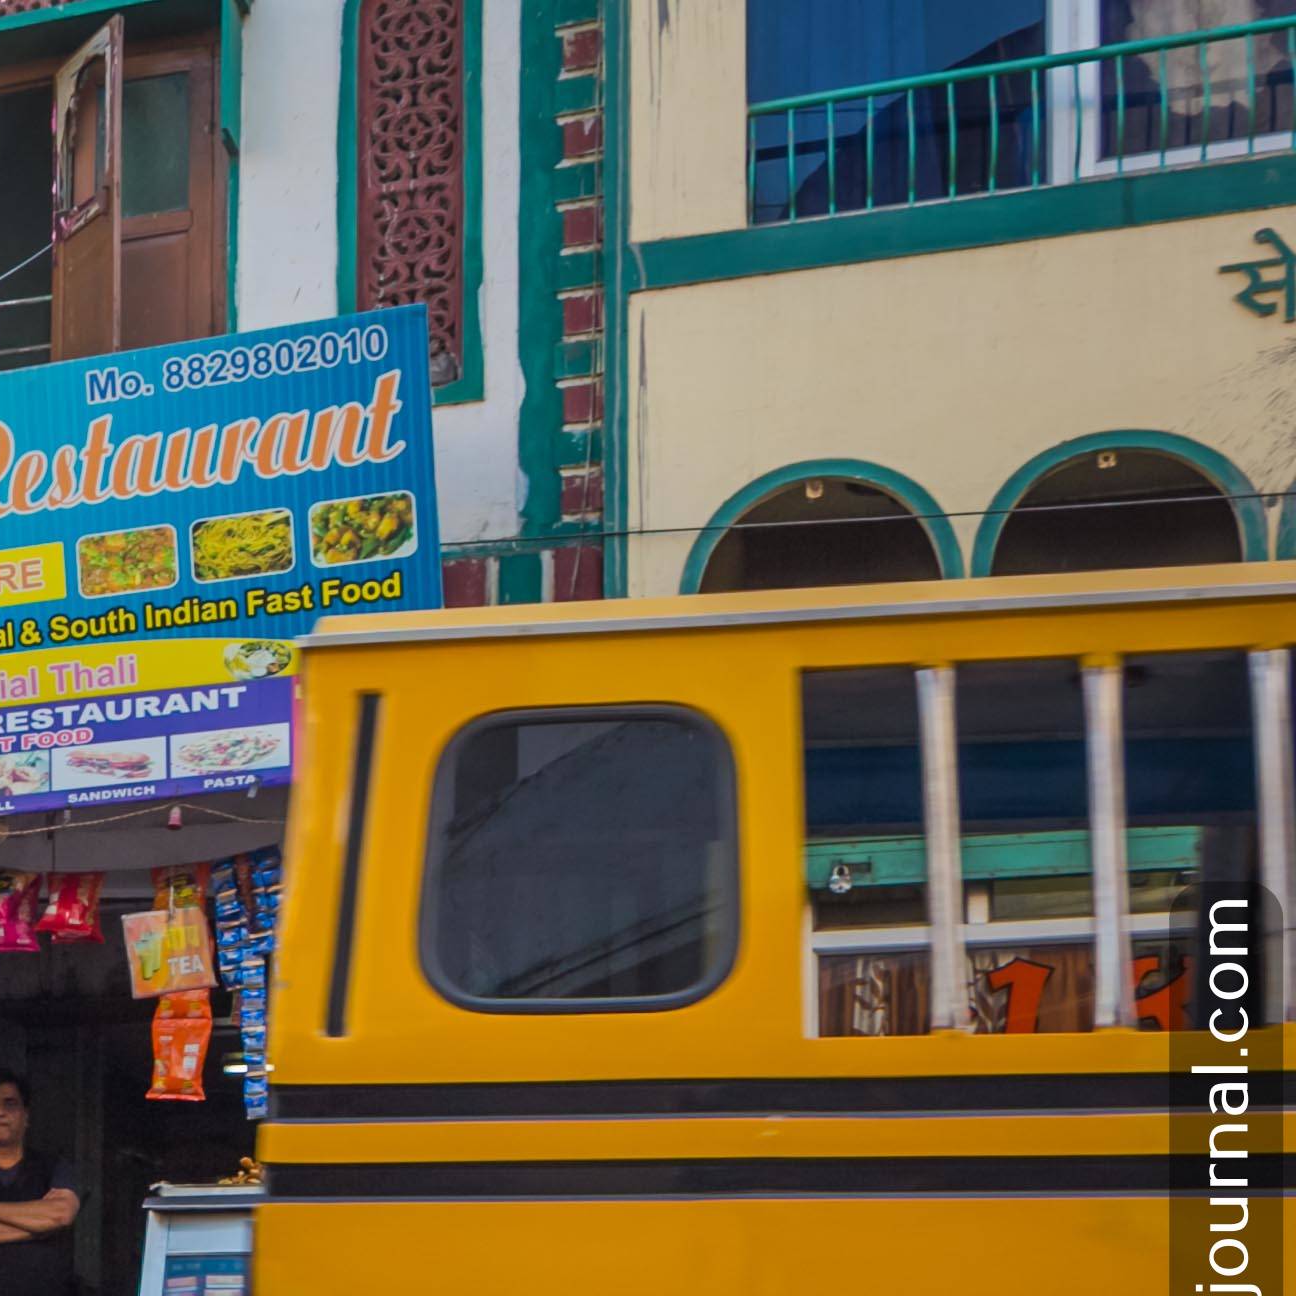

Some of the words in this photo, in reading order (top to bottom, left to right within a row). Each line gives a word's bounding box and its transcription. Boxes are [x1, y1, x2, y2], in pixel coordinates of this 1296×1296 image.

[87, 367, 154, 405] Mo.
[163, 325, 388, 392] 8829802010
[20, 616, 42, 645] &
[48, 607, 137, 643] South
[145, 598, 237, 631] Indian
[246, 585, 314, 617] Fast
[320, 573, 402, 606] Food
[49, 655, 137, 694] Thali
[20, 727, 94, 748] FOOD
[203, 774, 258, 789] PASTA
[68, 785, 156, 804] SANDWICH
[168, 954, 205, 976] TEA
